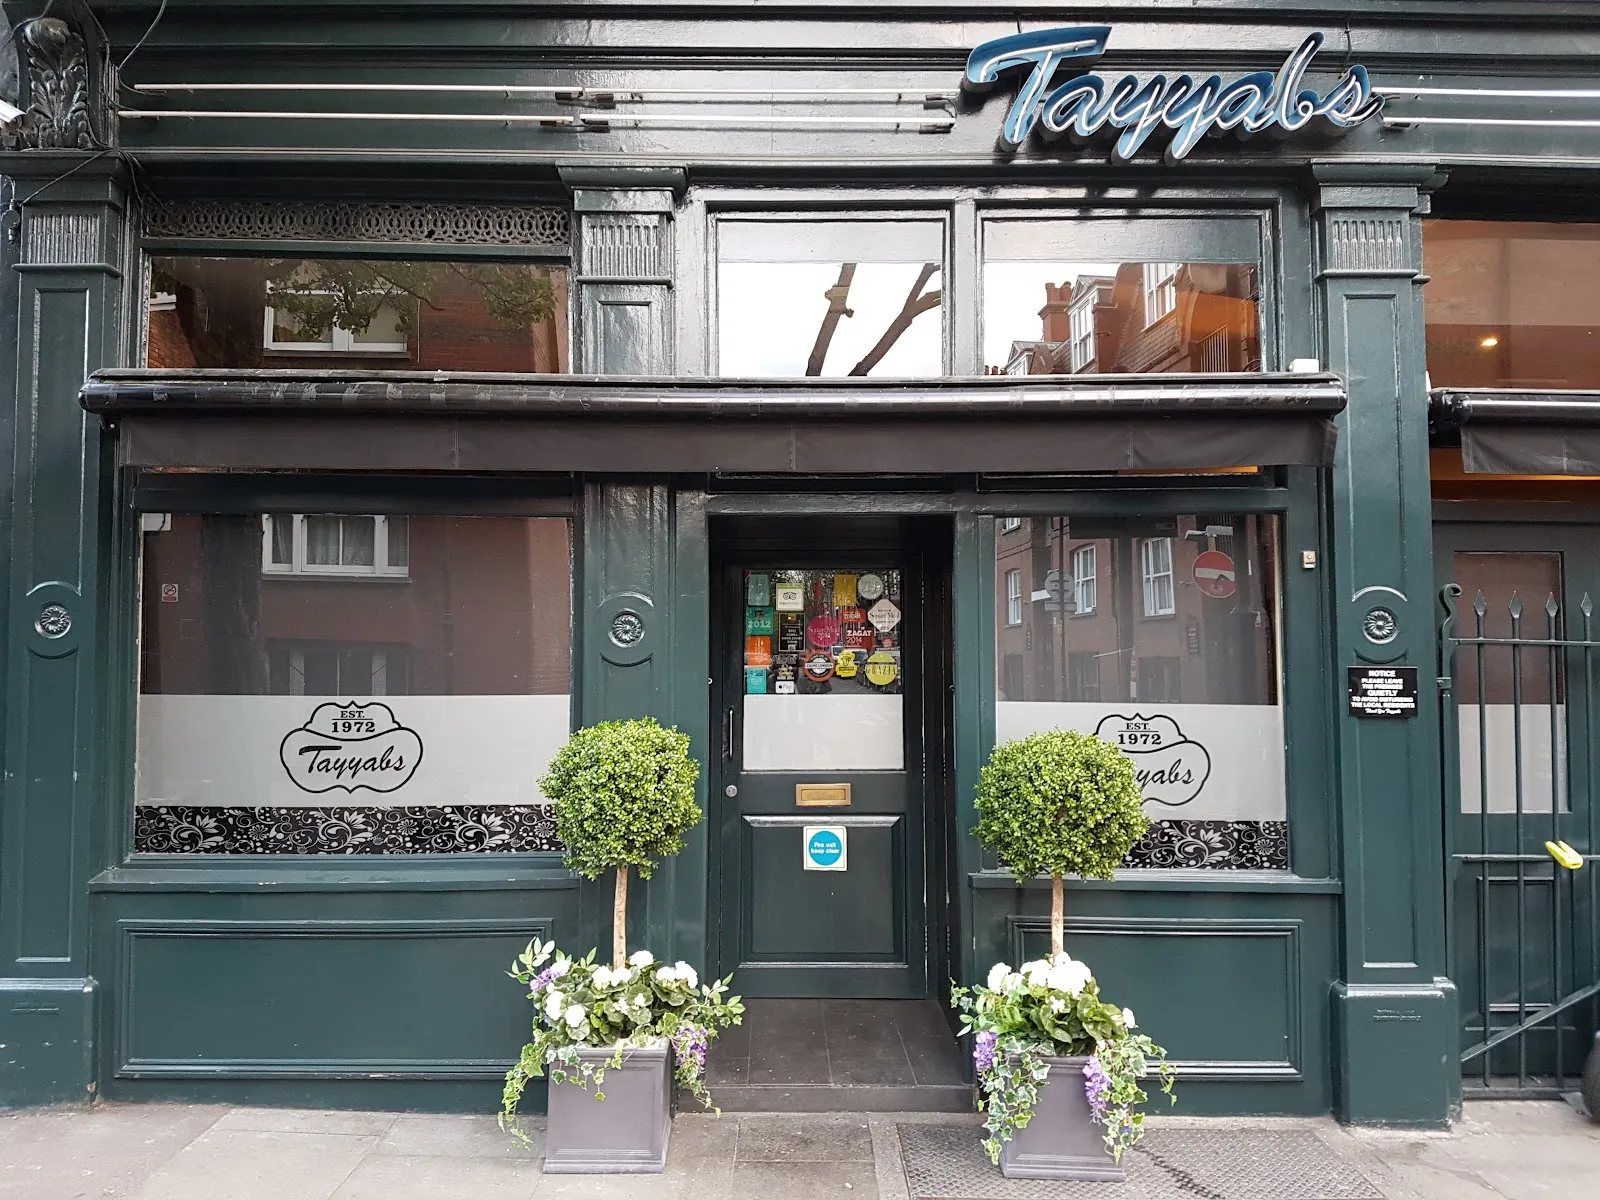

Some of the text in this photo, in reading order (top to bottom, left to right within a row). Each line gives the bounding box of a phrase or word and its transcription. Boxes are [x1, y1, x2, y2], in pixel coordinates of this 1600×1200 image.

[966, 25, 1385, 160] Tayyabs
[747, 620, 772, 628] 2012
[846, 629, 872, 637] ZAGAT
[340, 710, 365, 718] EST.
[331, 721, 376, 733] 1972
[1126, 722, 1151, 731] EST.
[1118, 733, 1162, 745] 1972
[298, 745, 406, 780] Tayyabs
[1135, 758, 1195, 792] yabs
